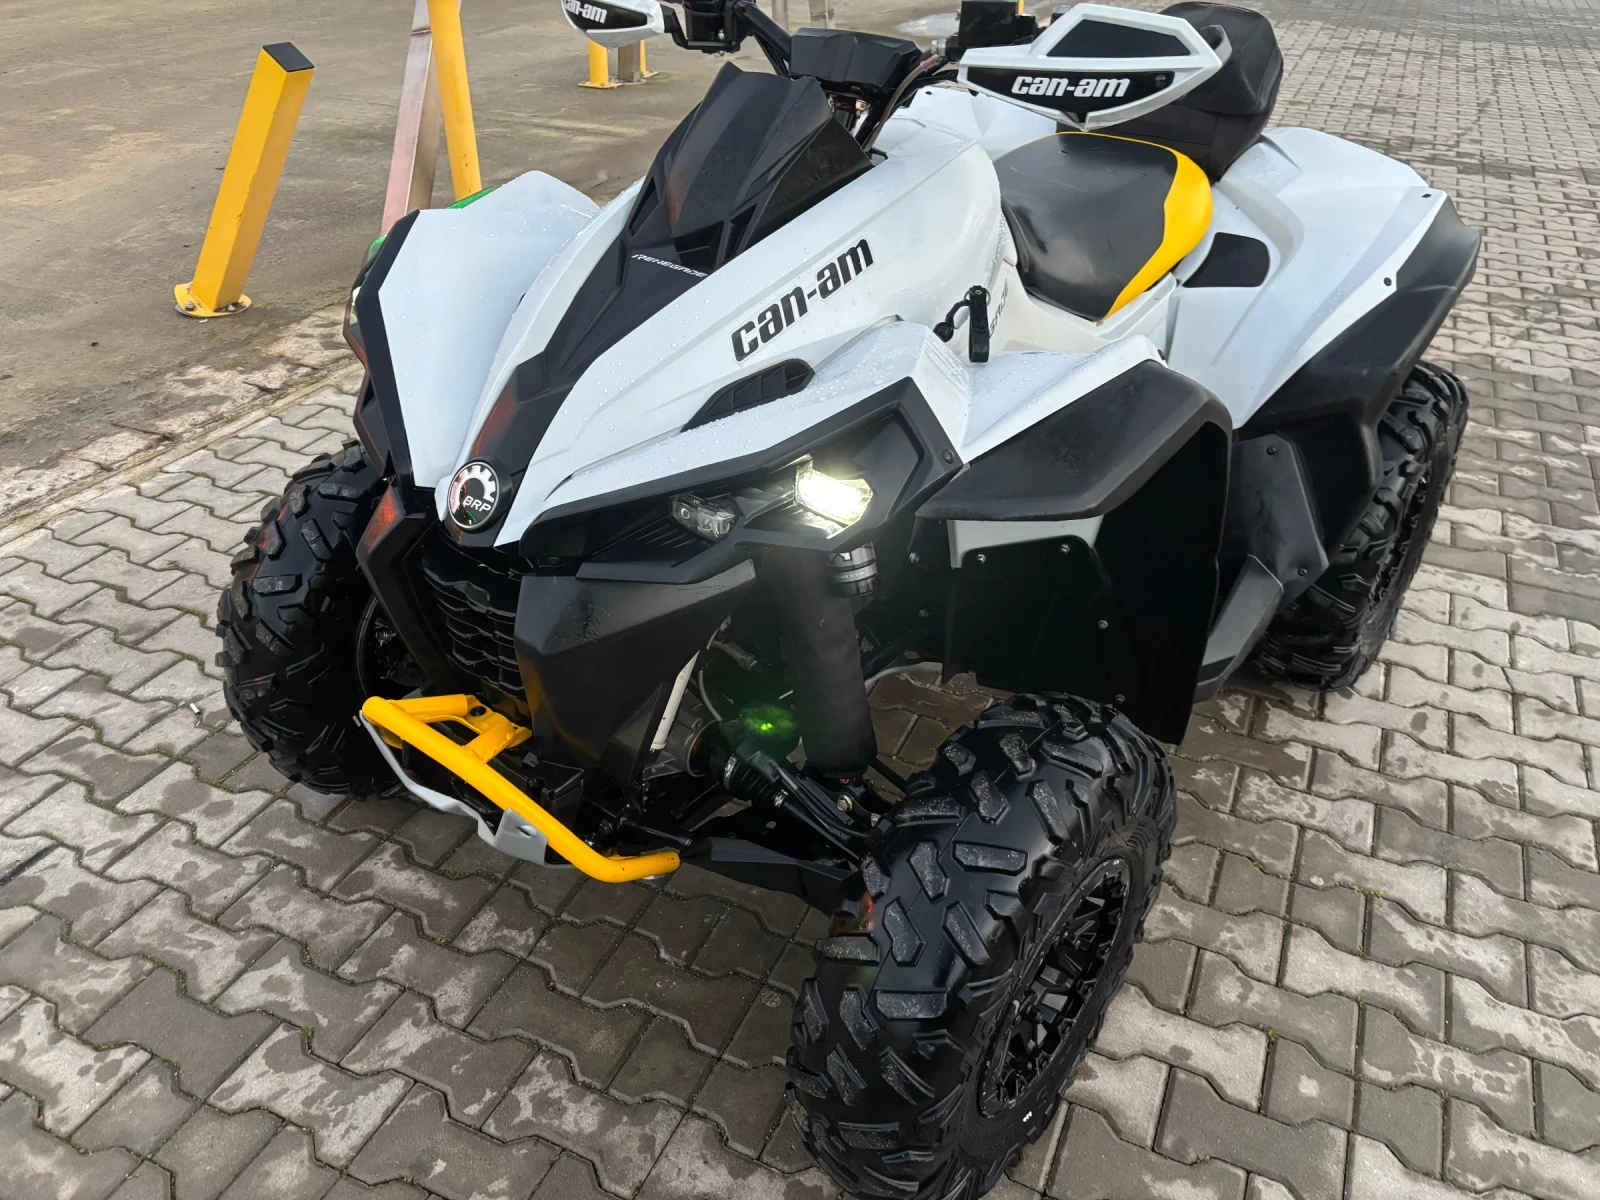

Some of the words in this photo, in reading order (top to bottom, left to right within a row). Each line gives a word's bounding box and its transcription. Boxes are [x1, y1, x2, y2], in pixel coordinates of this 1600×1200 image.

[1011, 75, 1131, 98] can-am
[631, 253, 708, 279] RENEGADE
[731, 238, 874, 362] can-am
[463, 495, 492, 512] BRP
